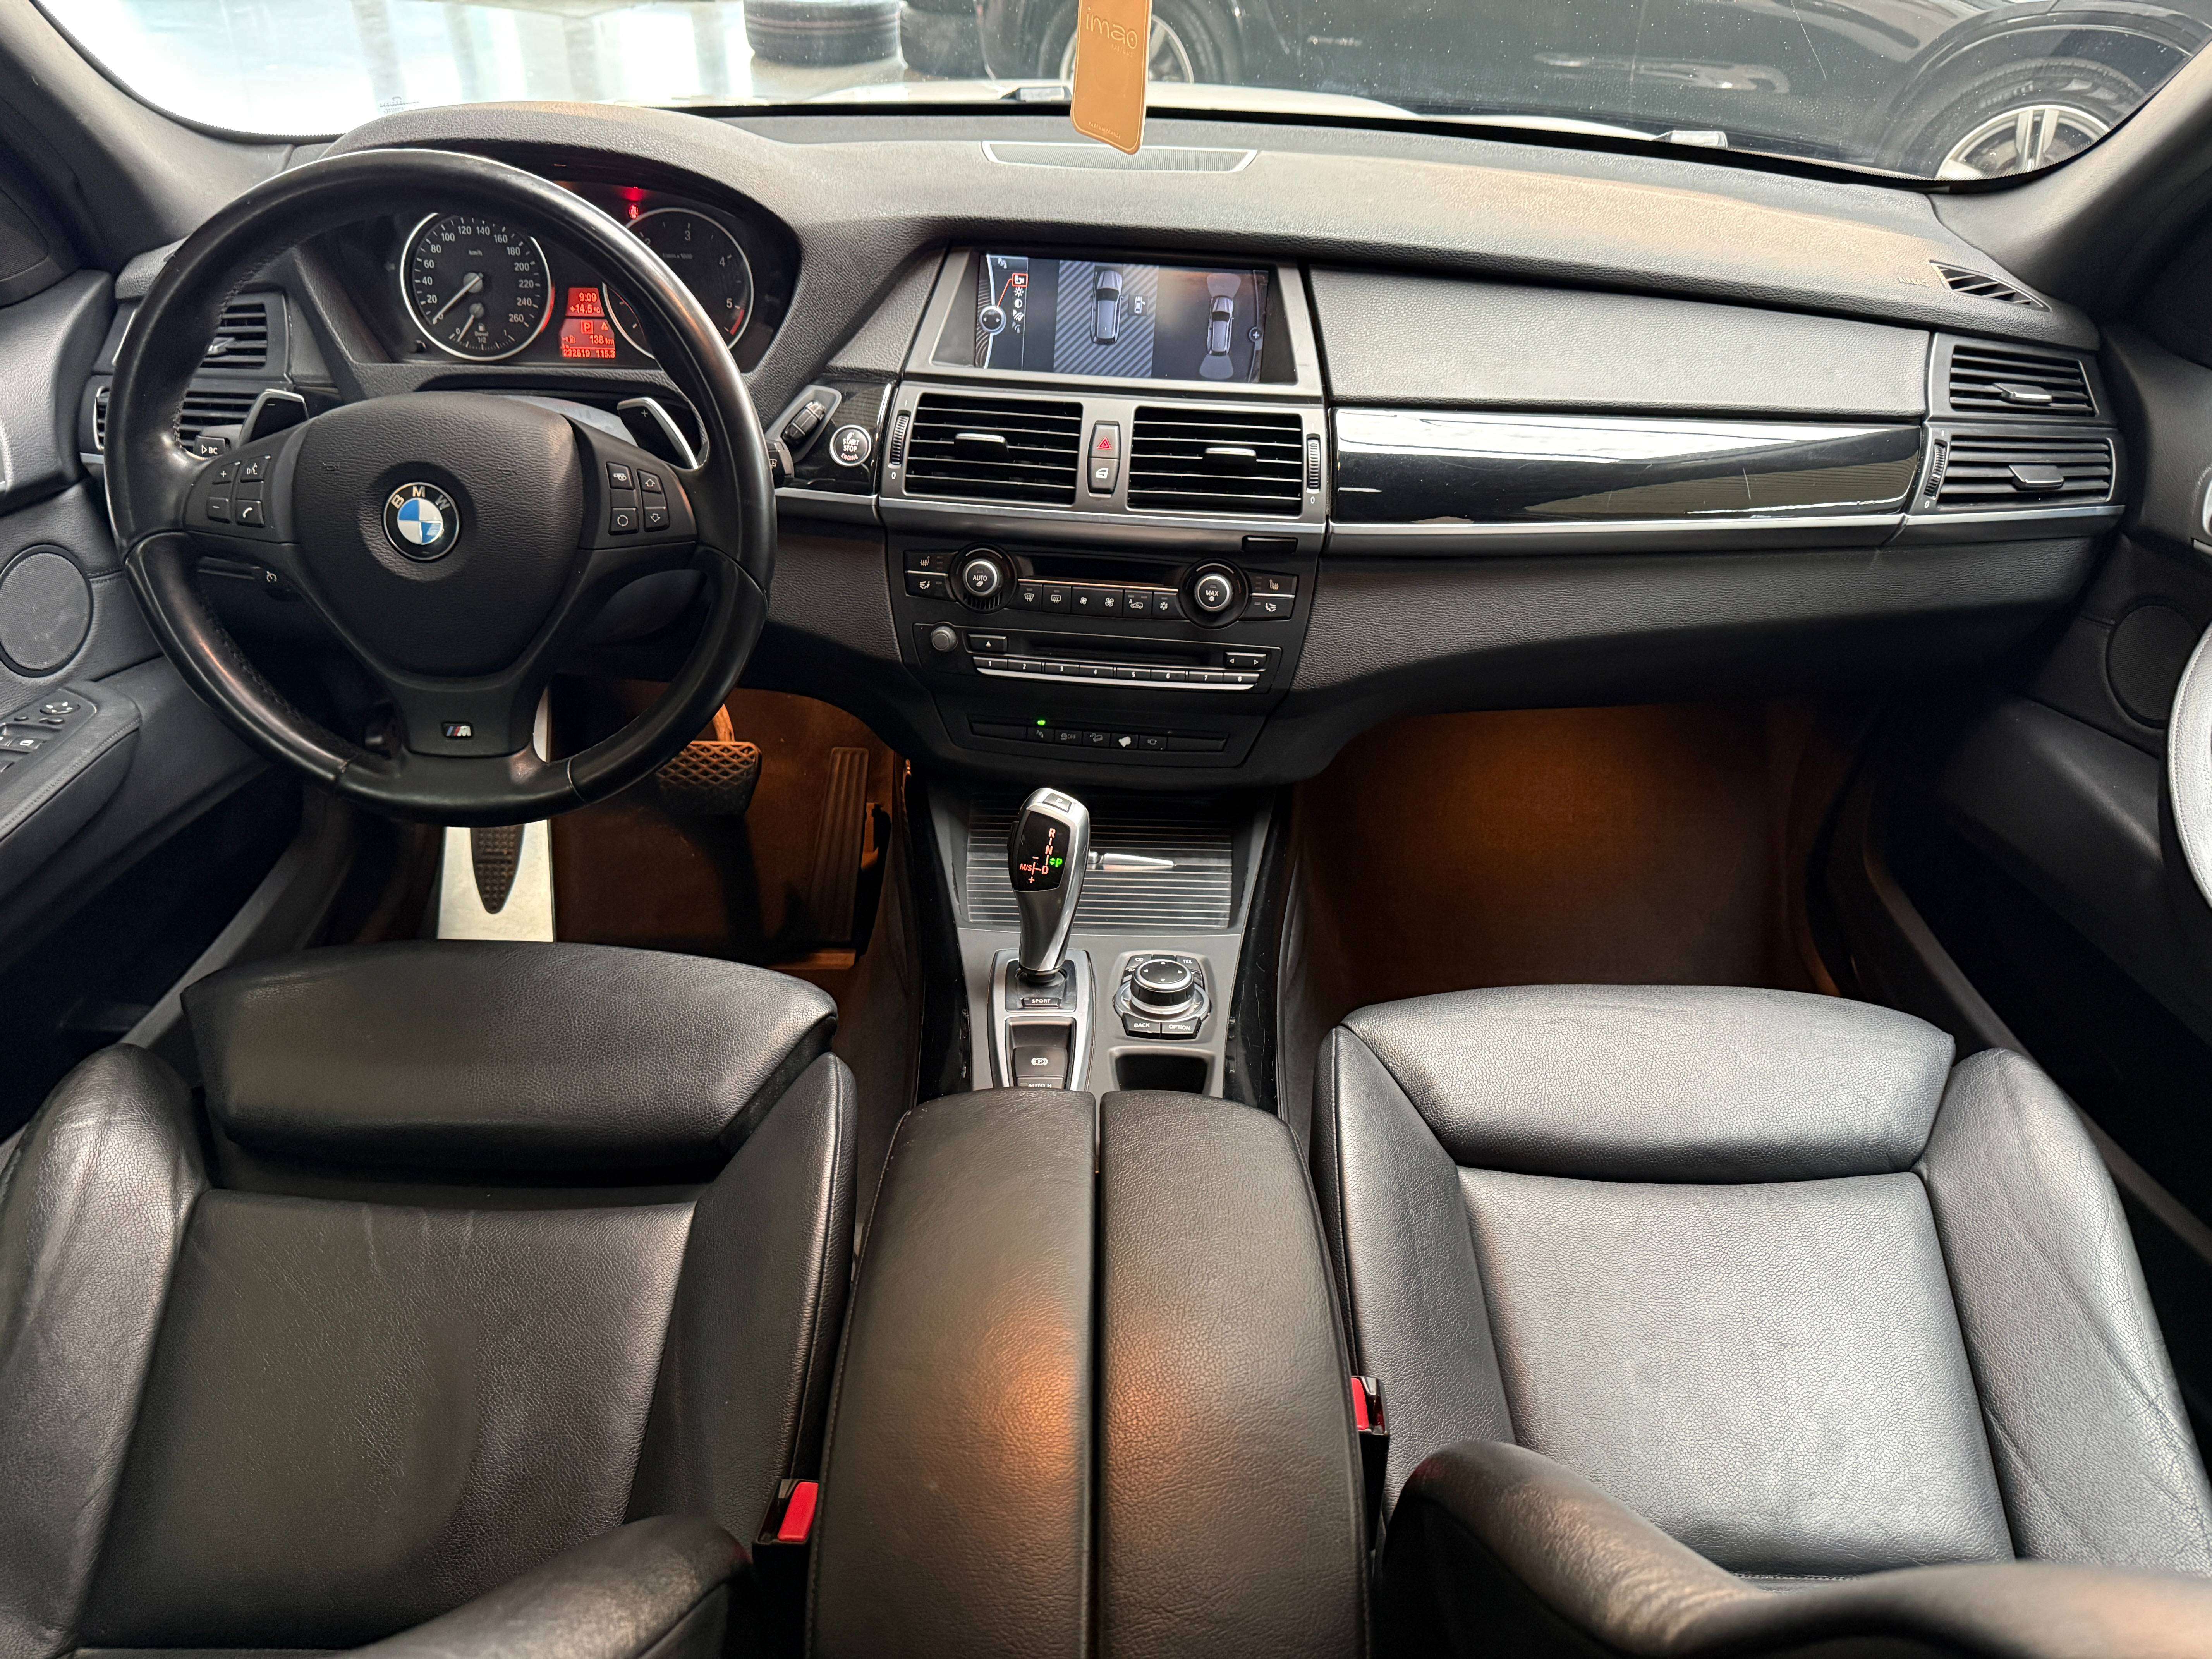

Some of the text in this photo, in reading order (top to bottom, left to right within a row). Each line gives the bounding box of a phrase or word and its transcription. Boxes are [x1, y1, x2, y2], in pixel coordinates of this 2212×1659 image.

[1086, 6, 1138, 50] imao
[458, 226, 471, 235] 120
[476, 227, 490, 235] 140
[441, 233, 455, 242] 100
[494, 235, 508, 243] 160
[685, 230, 691, 241] 3
[431, 245, 441, 253] 80
[507, 247, 520, 256] 180
[424, 260, 434, 268] 60
[719, 256, 725, 267] 4
[514, 262, 529, 271] 200
[422, 276, 433, 285] 40
[519, 279, 534, 288] 220
[427, 294, 437, 304] 20
[517, 297, 532, 306] 240
[579, 292, 597, 302] 9:09
[726, 298, 733, 308] 5
[508, 314, 524, 323] 260
[584, 322, 591, 332] P
[589, 335, 604, 344] 138
[841, 453, 858, 461] ENGINE
[390, 486, 450, 510] BMW
[1049, 828, 1056, 838] R
[1045, 845, 1053, 855] N
[1055, 858, 1063, 867] P
[1020, 863, 1032, 872] M/S
[1041, 865, 1049, 875] D
